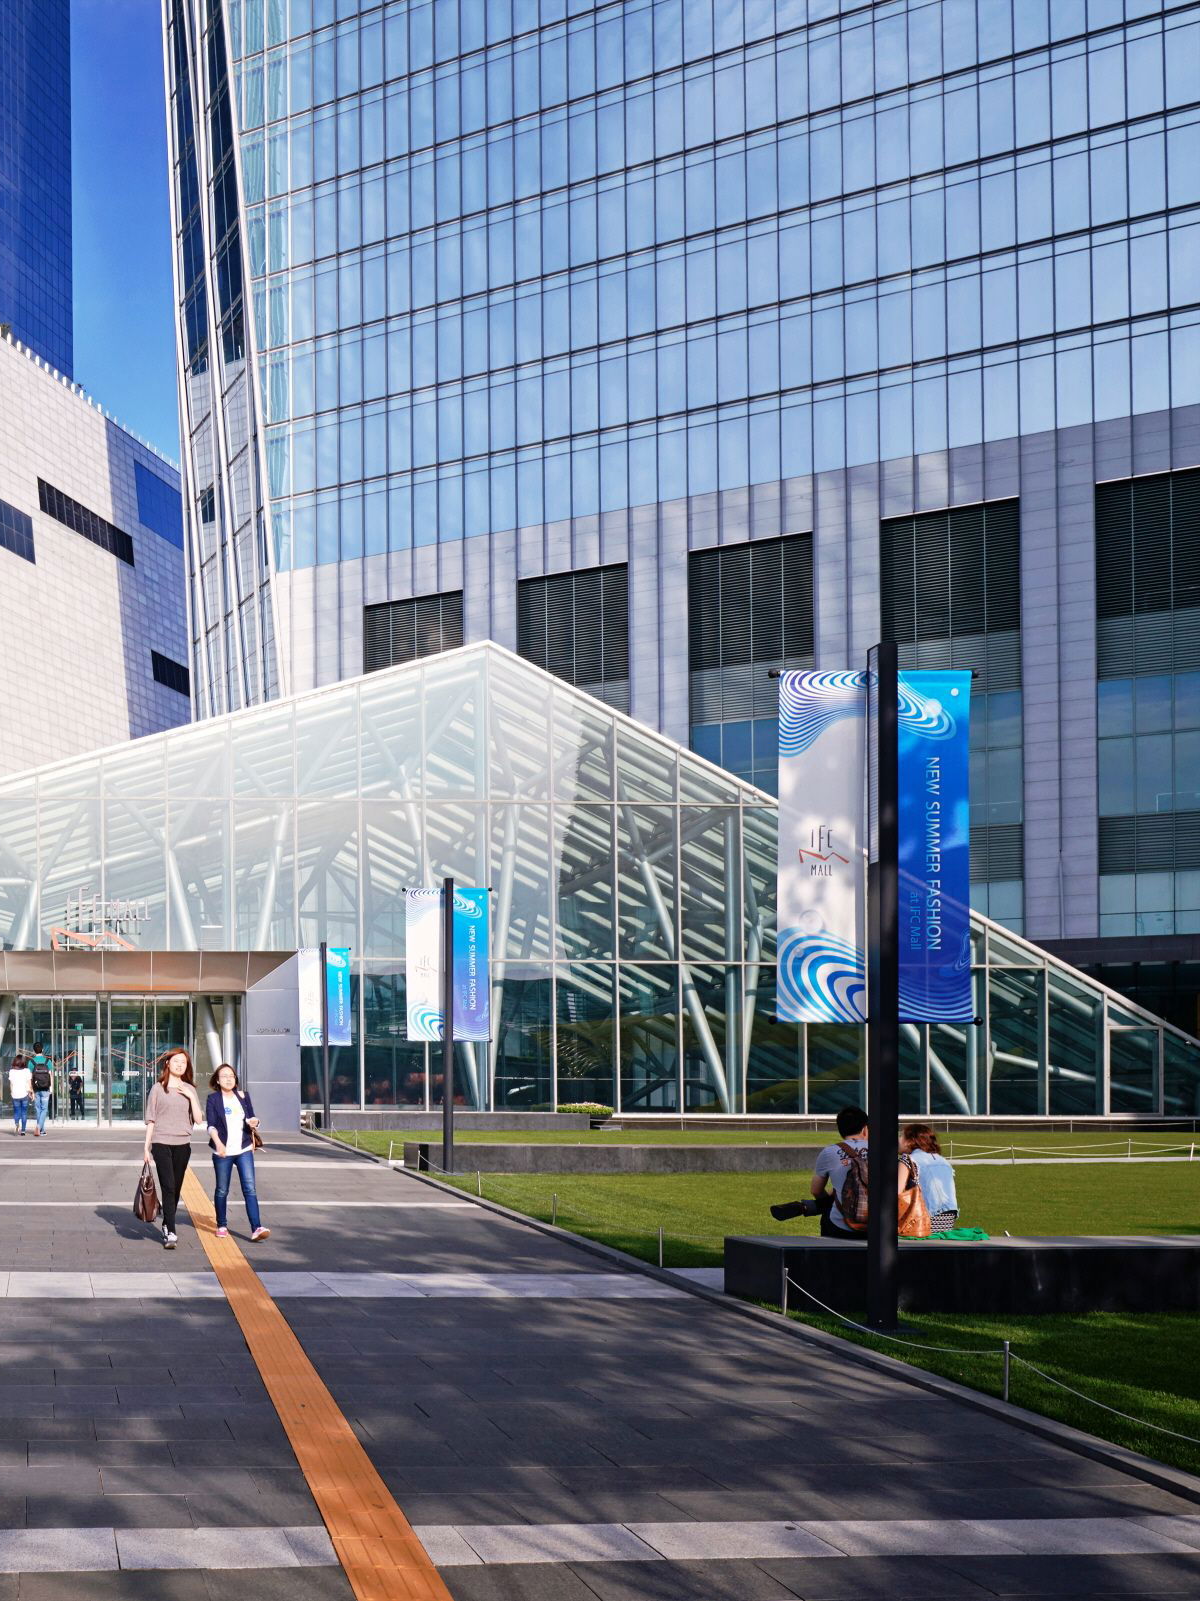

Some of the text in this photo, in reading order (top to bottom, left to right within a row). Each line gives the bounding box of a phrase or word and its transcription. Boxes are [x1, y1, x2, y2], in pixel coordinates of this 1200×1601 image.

[811, 825, 833, 852] IFC
[926, 757, 942, 950] NEW SUMMER FASHION
[810, 864, 833, 876] MALL
[910, 891, 922, 950] at IFC Mall
[468, 925, 476, 1011] NEW SUMMER FASHION
